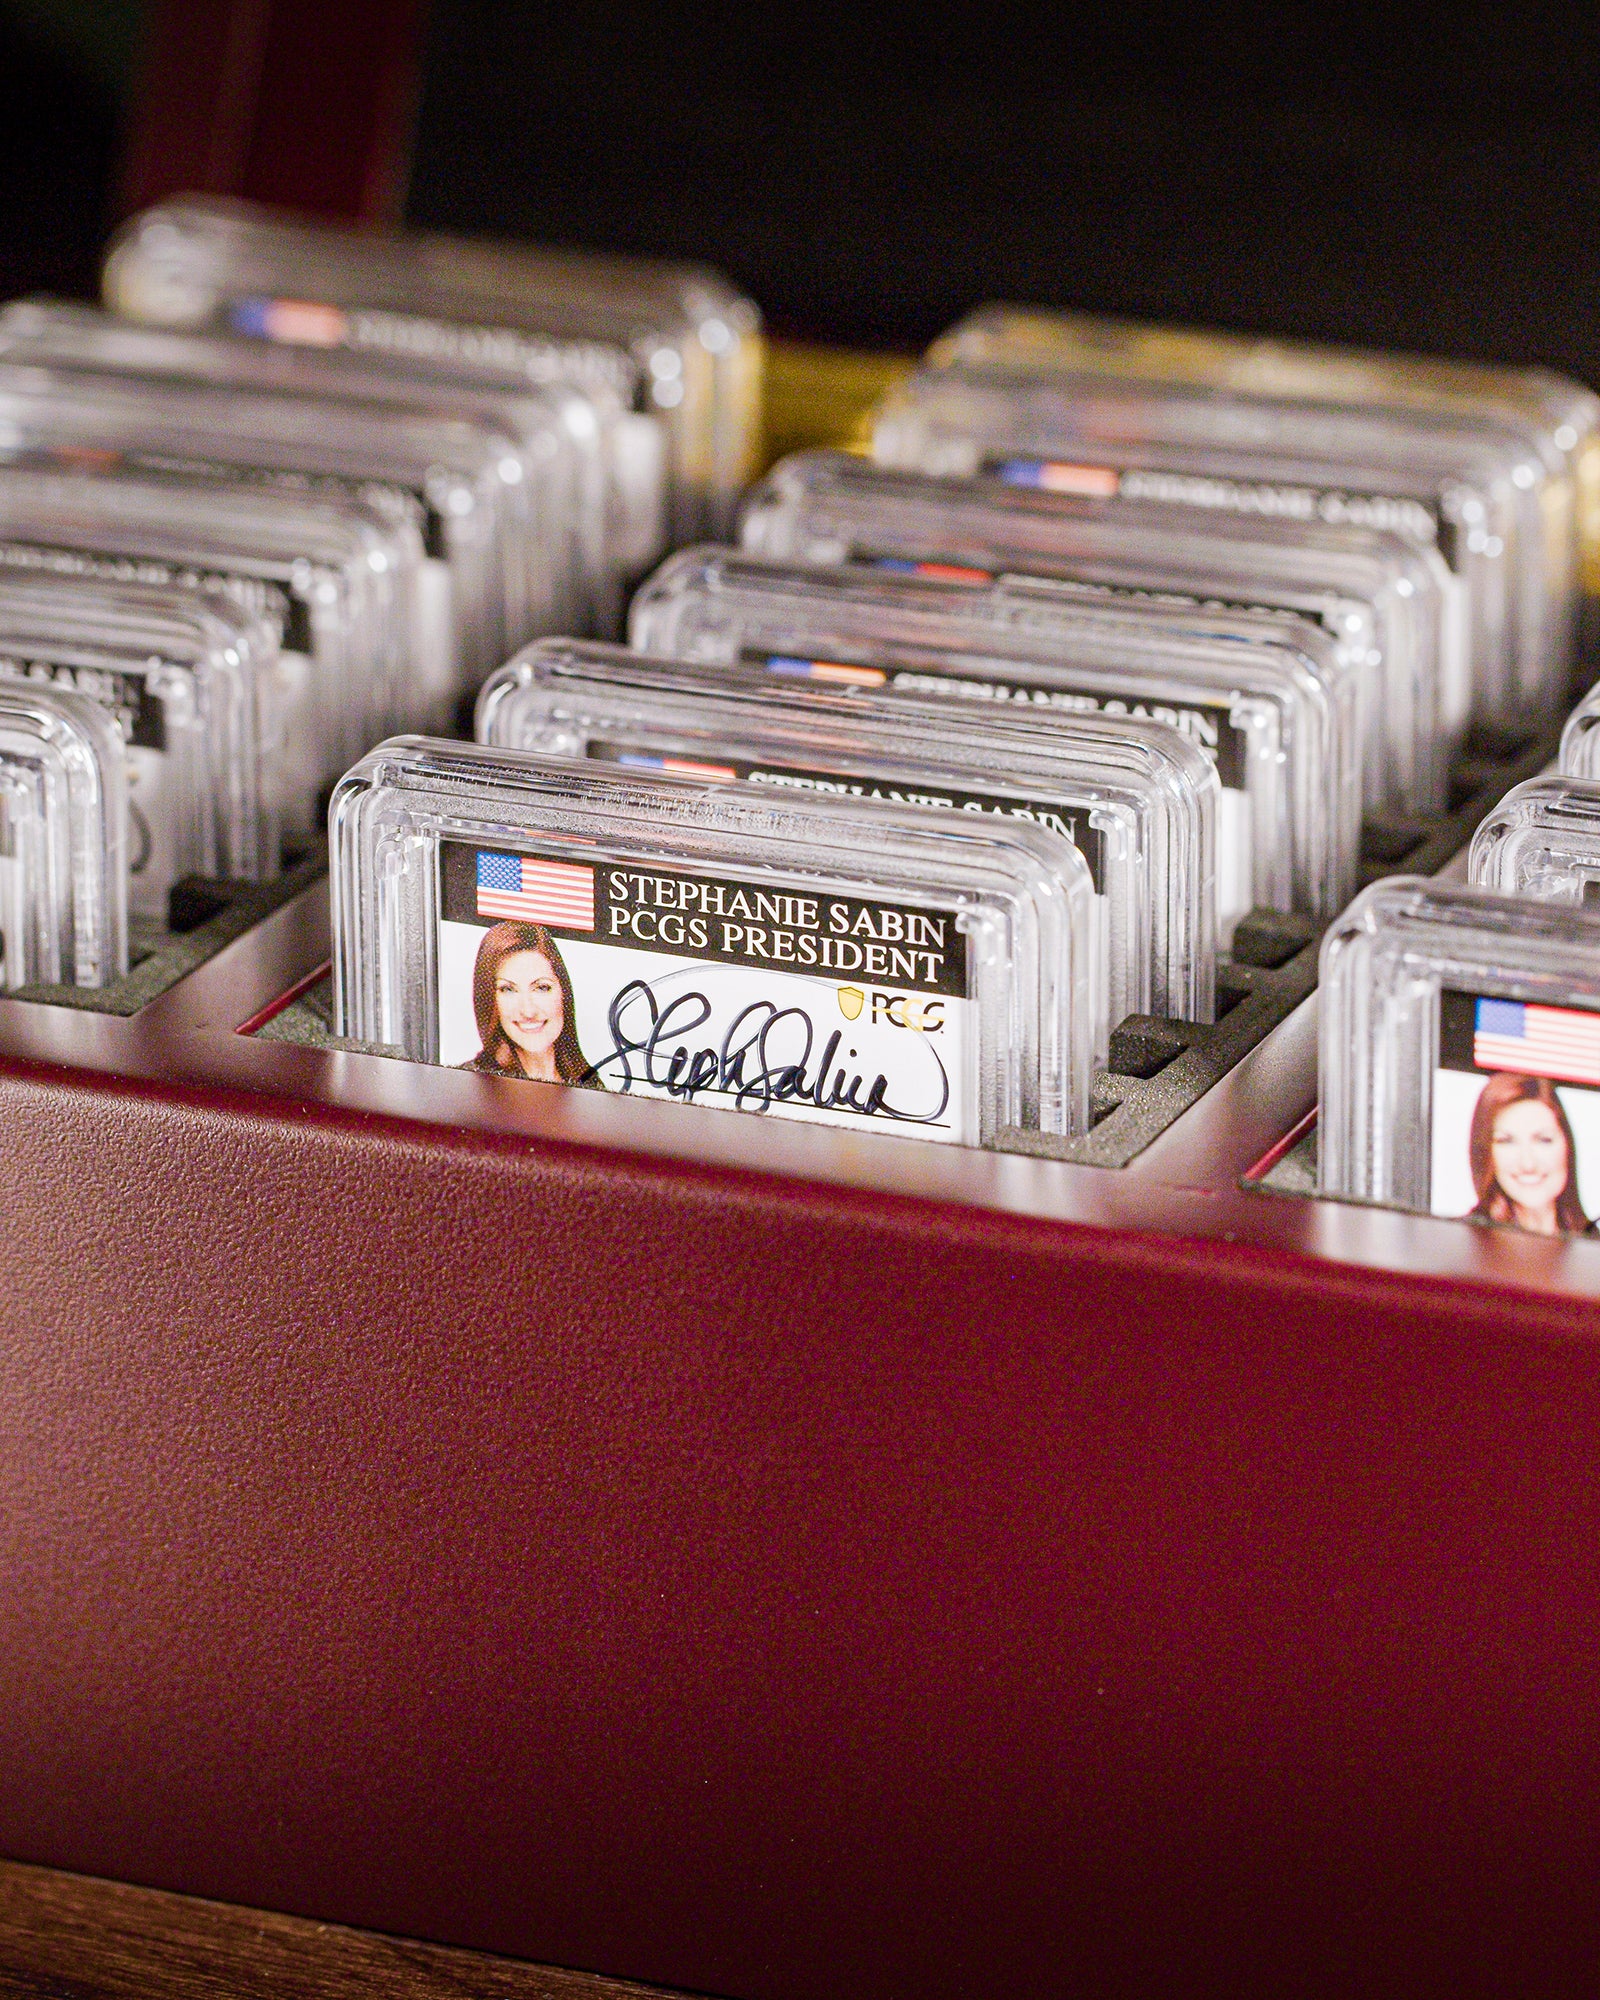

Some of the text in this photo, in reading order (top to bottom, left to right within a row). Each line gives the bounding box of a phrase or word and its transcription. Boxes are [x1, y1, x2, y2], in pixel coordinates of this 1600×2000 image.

[609, 871, 945, 948] STEPHANIE SABIN
[609, 907, 944, 983] PCGS PRESIDENT
